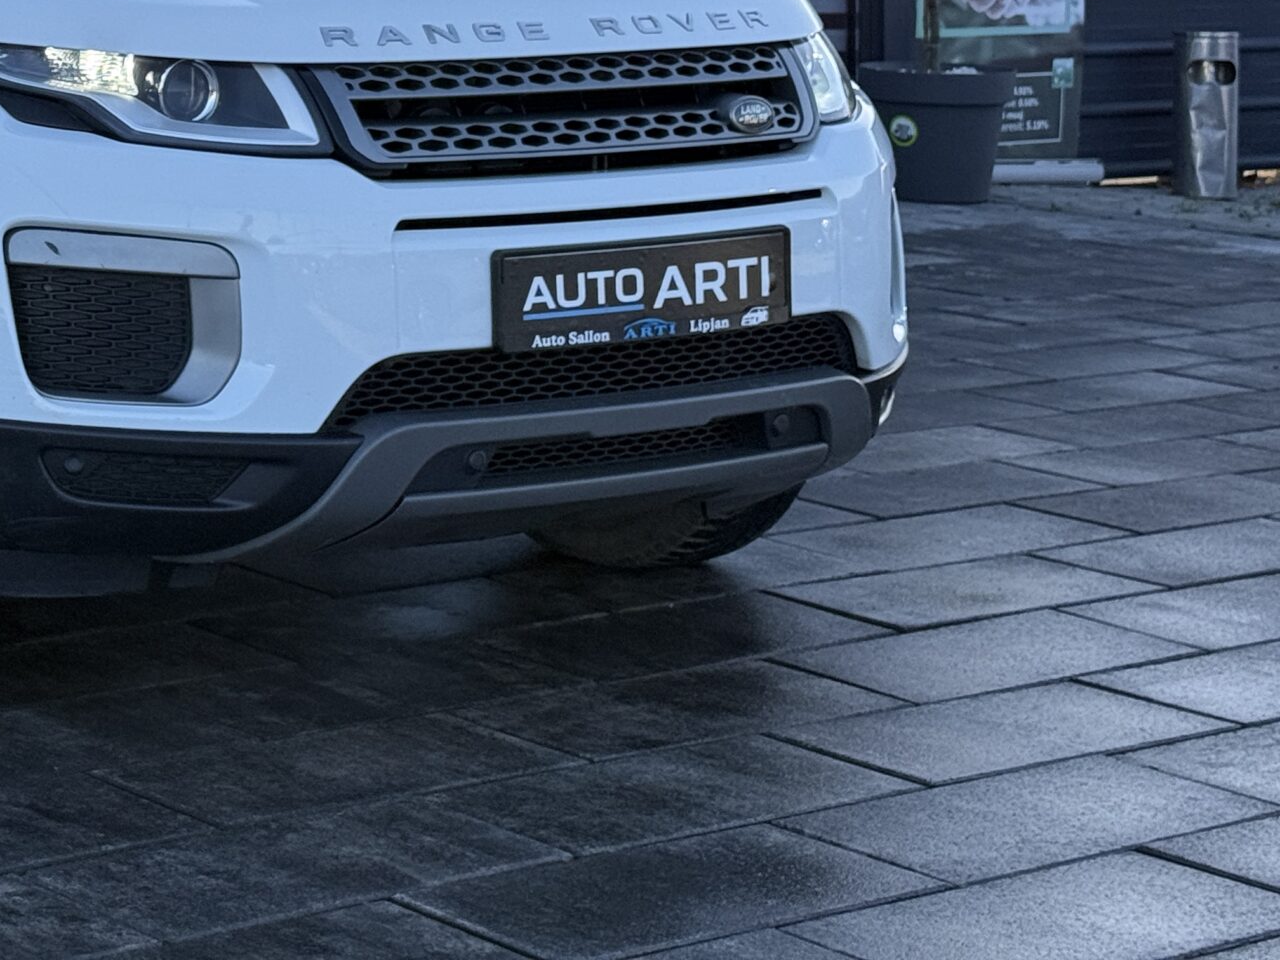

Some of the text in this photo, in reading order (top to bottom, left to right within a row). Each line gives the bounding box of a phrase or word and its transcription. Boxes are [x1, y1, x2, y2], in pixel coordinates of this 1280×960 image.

[320, 9, 770, 48] RANGE ROVER
[740, 104, 761, 115] LAND
[744, 113, 768, 125] ROVER
[522, 255, 770, 312] AUTO ARTI
[624, 323, 676, 339] ARTI
[689, 317, 730, 333] Lipjan
[531, 330, 610, 349] Auto Sallon
